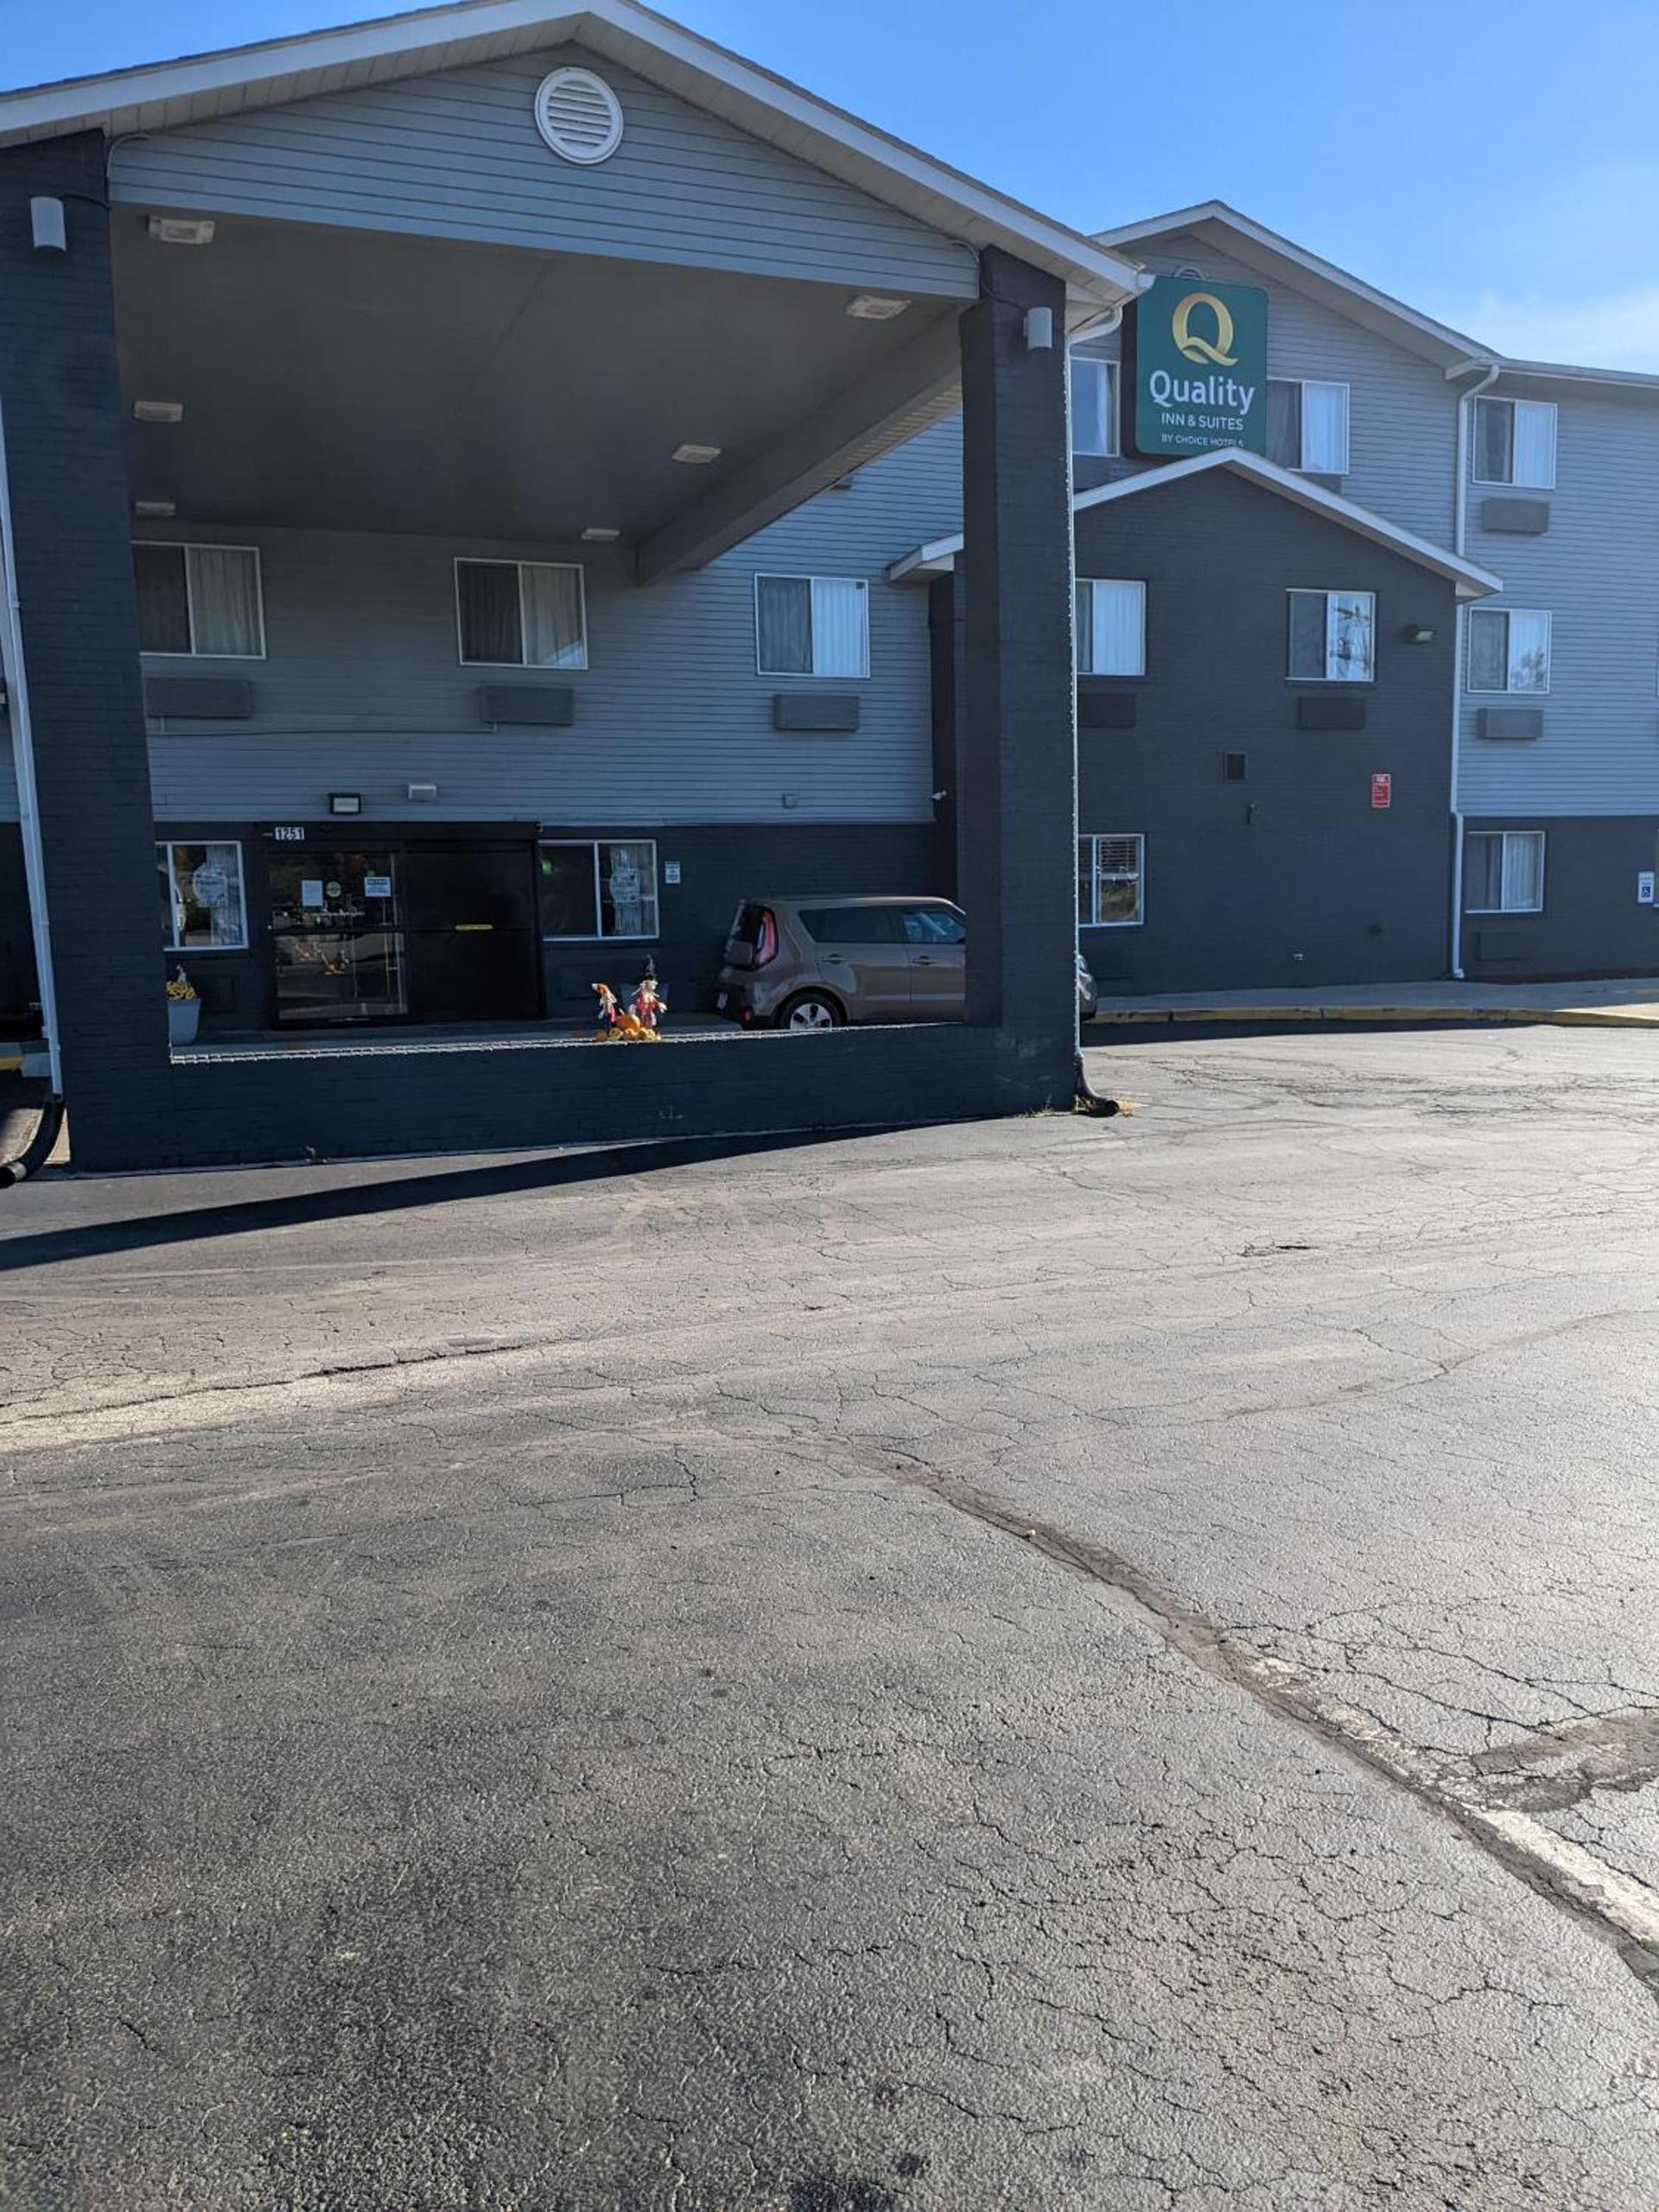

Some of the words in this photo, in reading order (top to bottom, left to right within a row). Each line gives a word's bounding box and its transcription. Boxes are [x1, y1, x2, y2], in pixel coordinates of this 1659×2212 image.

[1172, 292, 1239, 367] Q
[1149, 370, 1255, 416] Quality
[1161, 412, 1185, 426] INN
[1187, 415, 1197, 428] &
[1198, 415, 1244, 431] SUITES
[1161, 433, 1174, 443] BY
[1175, 435, 1209, 446] CHOICE
[276, 827, 305, 840] 1251
